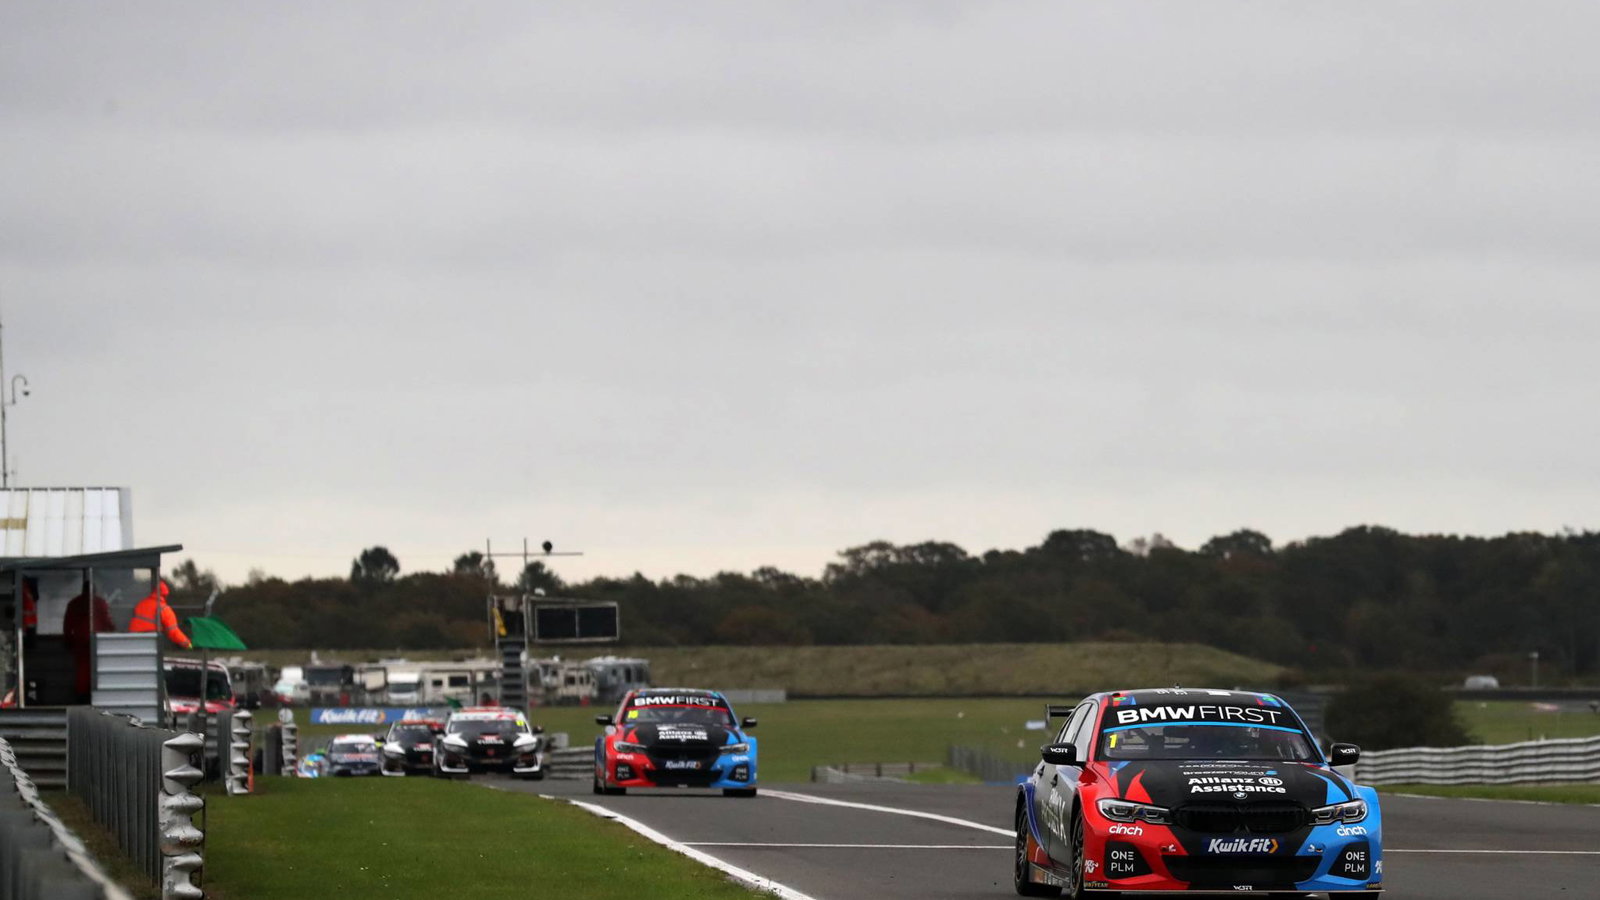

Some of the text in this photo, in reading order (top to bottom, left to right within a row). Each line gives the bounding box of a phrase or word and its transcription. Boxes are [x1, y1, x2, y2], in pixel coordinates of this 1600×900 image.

[1109, 734, 1118, 749] 1
[1188, 777, 1255, 785] Allianz
[1190, 784, 1286, 794] Assistance
[1108, 823, 1143, 836] cinch
[1336, 825, 1367, 837] cinch
[1111, 850, 1134, 861] ONE
[1345, 851, 1365, 861] ONE
[1110, 862, 1134, 872] PLM
[1344, 863, 1365, 873] PLM
